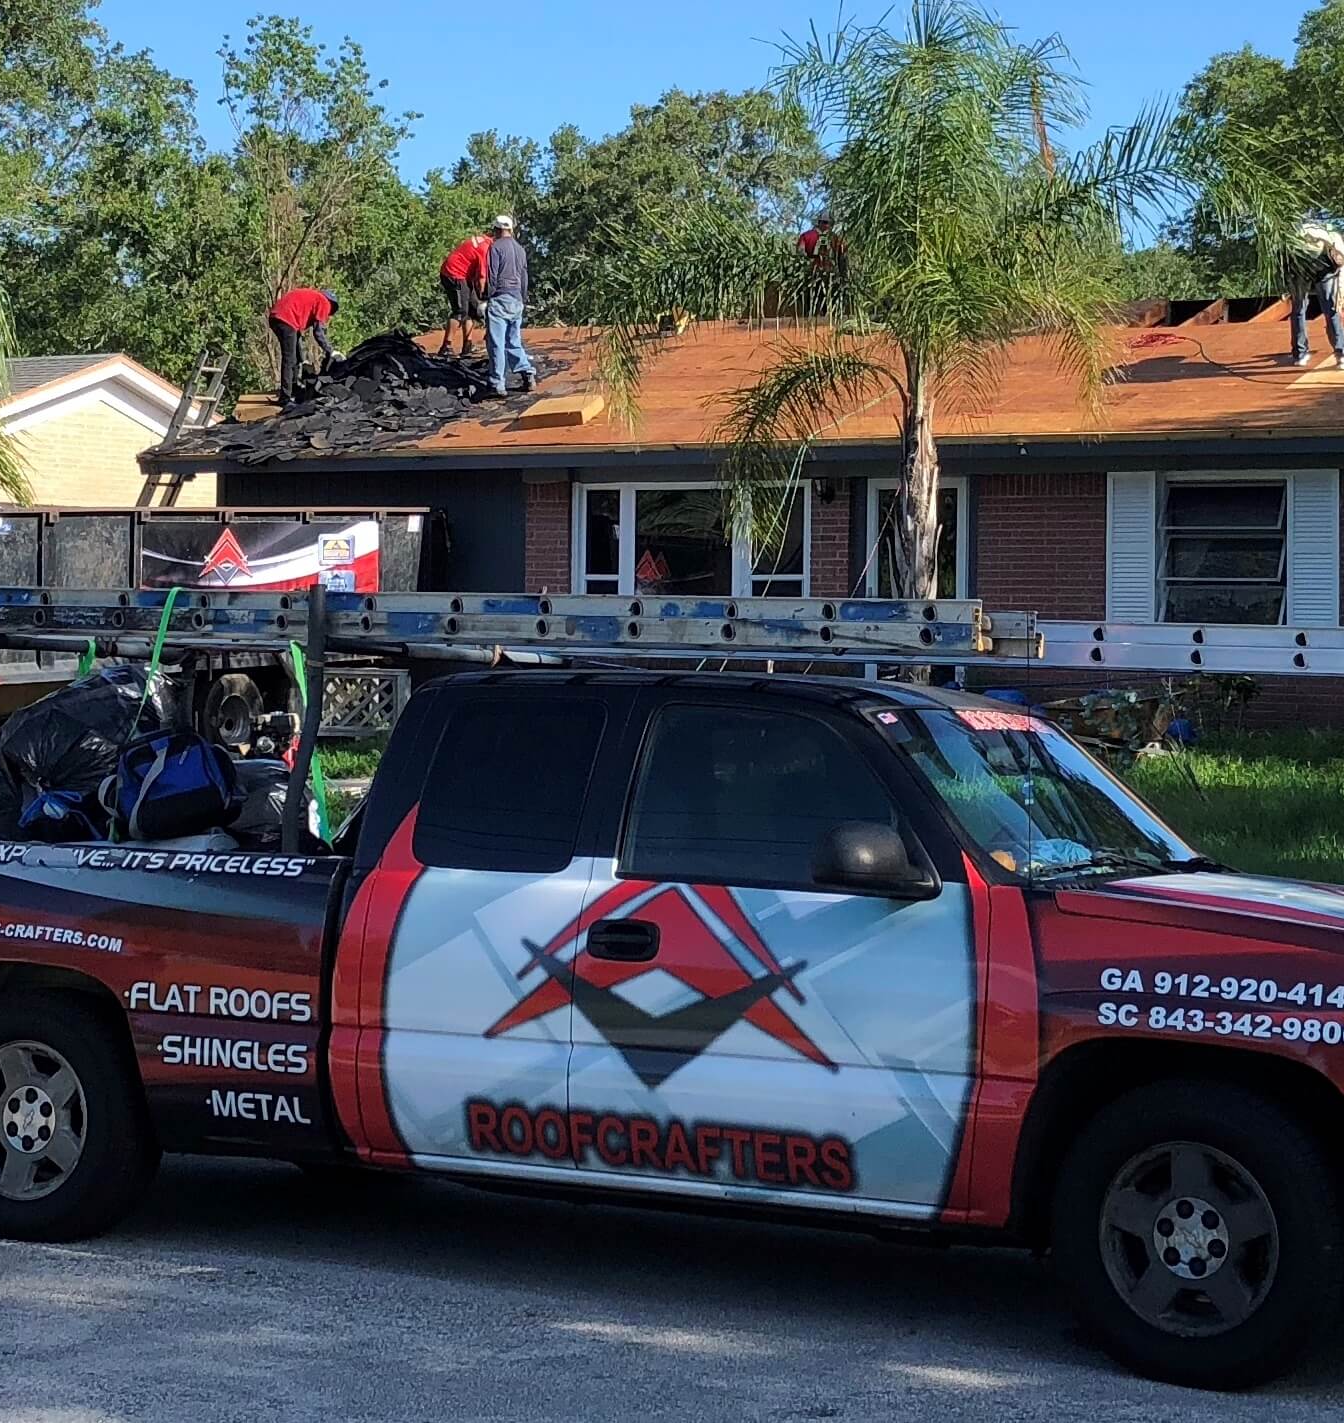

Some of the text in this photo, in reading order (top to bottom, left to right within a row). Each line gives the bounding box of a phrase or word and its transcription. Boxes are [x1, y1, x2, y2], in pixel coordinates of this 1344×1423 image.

[121, 851, 170, 870] IT'S
[168, 853, 317, 877] PRICELESS"
[1100, 967, 1145, 993] GA
[209, 986, 312, 1022] ROOFS
[1096, 1002, 1139, 1027] SC
[468, 1102, 854, 1190] ROOFCRAFTERS
